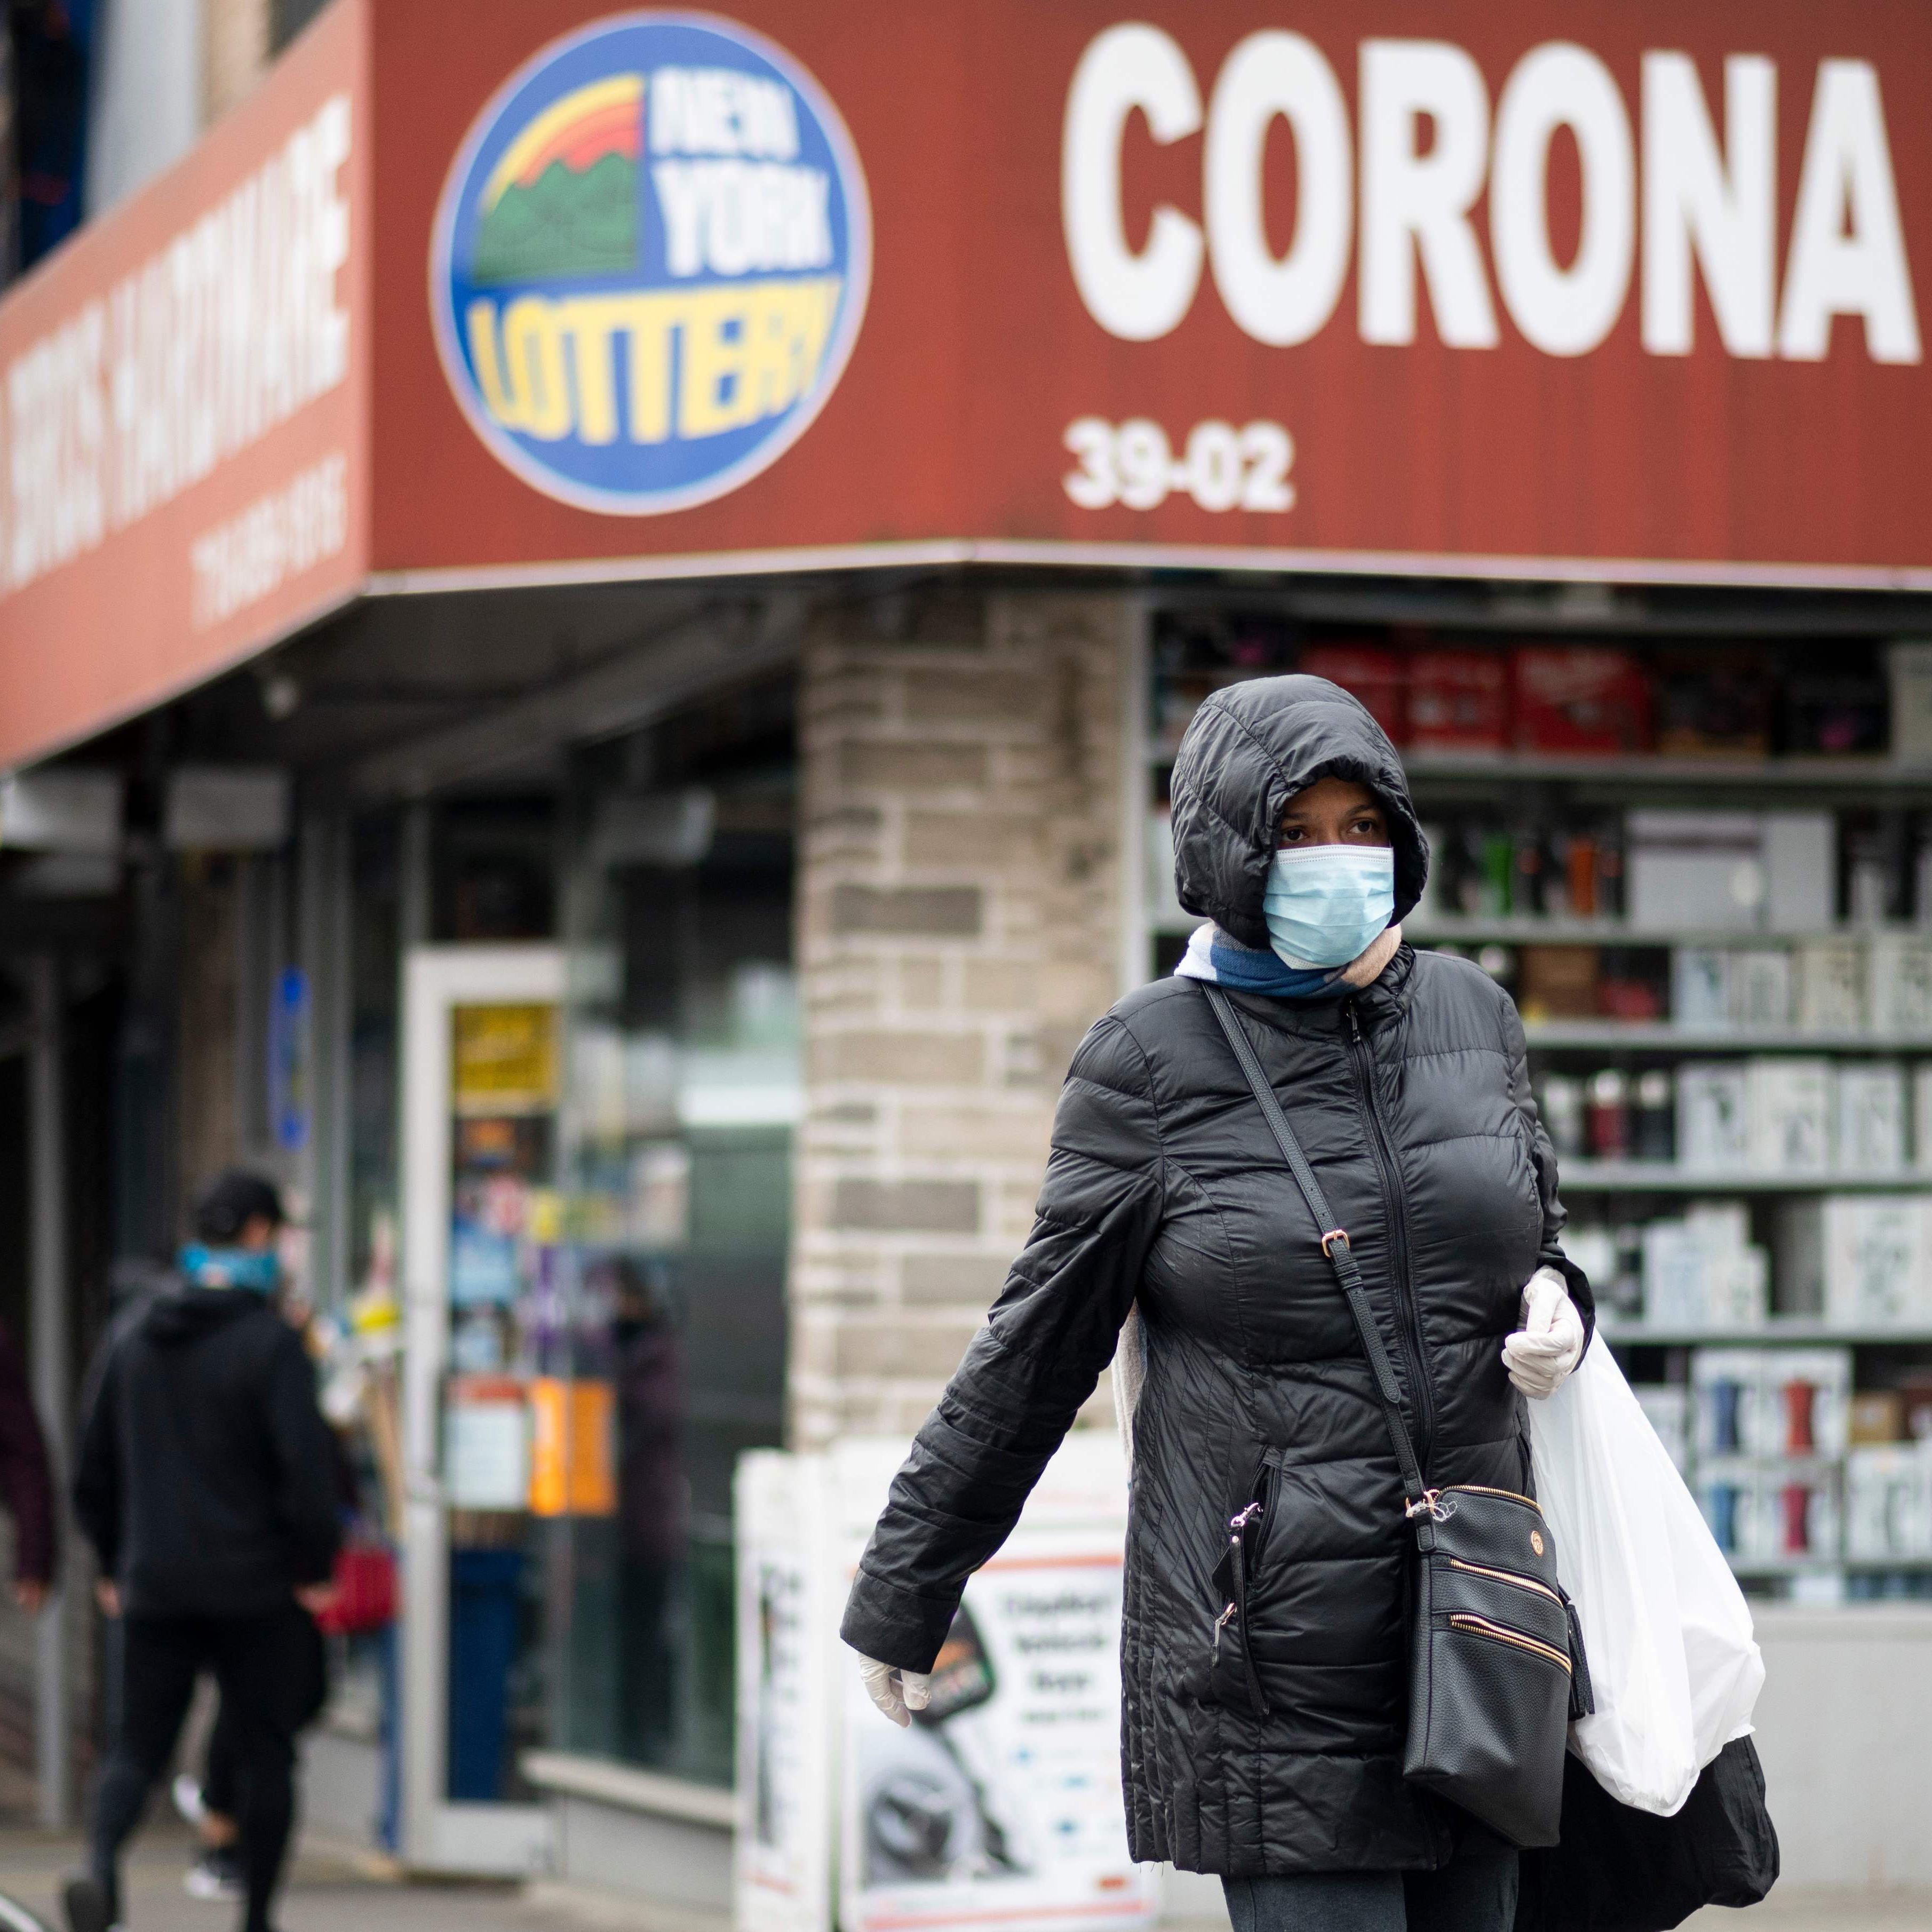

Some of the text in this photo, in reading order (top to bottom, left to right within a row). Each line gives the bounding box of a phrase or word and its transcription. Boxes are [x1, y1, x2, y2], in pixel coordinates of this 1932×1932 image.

[650, 65, 800, 161] NEW
[651, 158, 834, 277] YORK
[1060, 20, 1922, 364] CORONA
[466, 275, 843, 445] LOTTERY
[1061, 416, 1297, 514] 39-02
